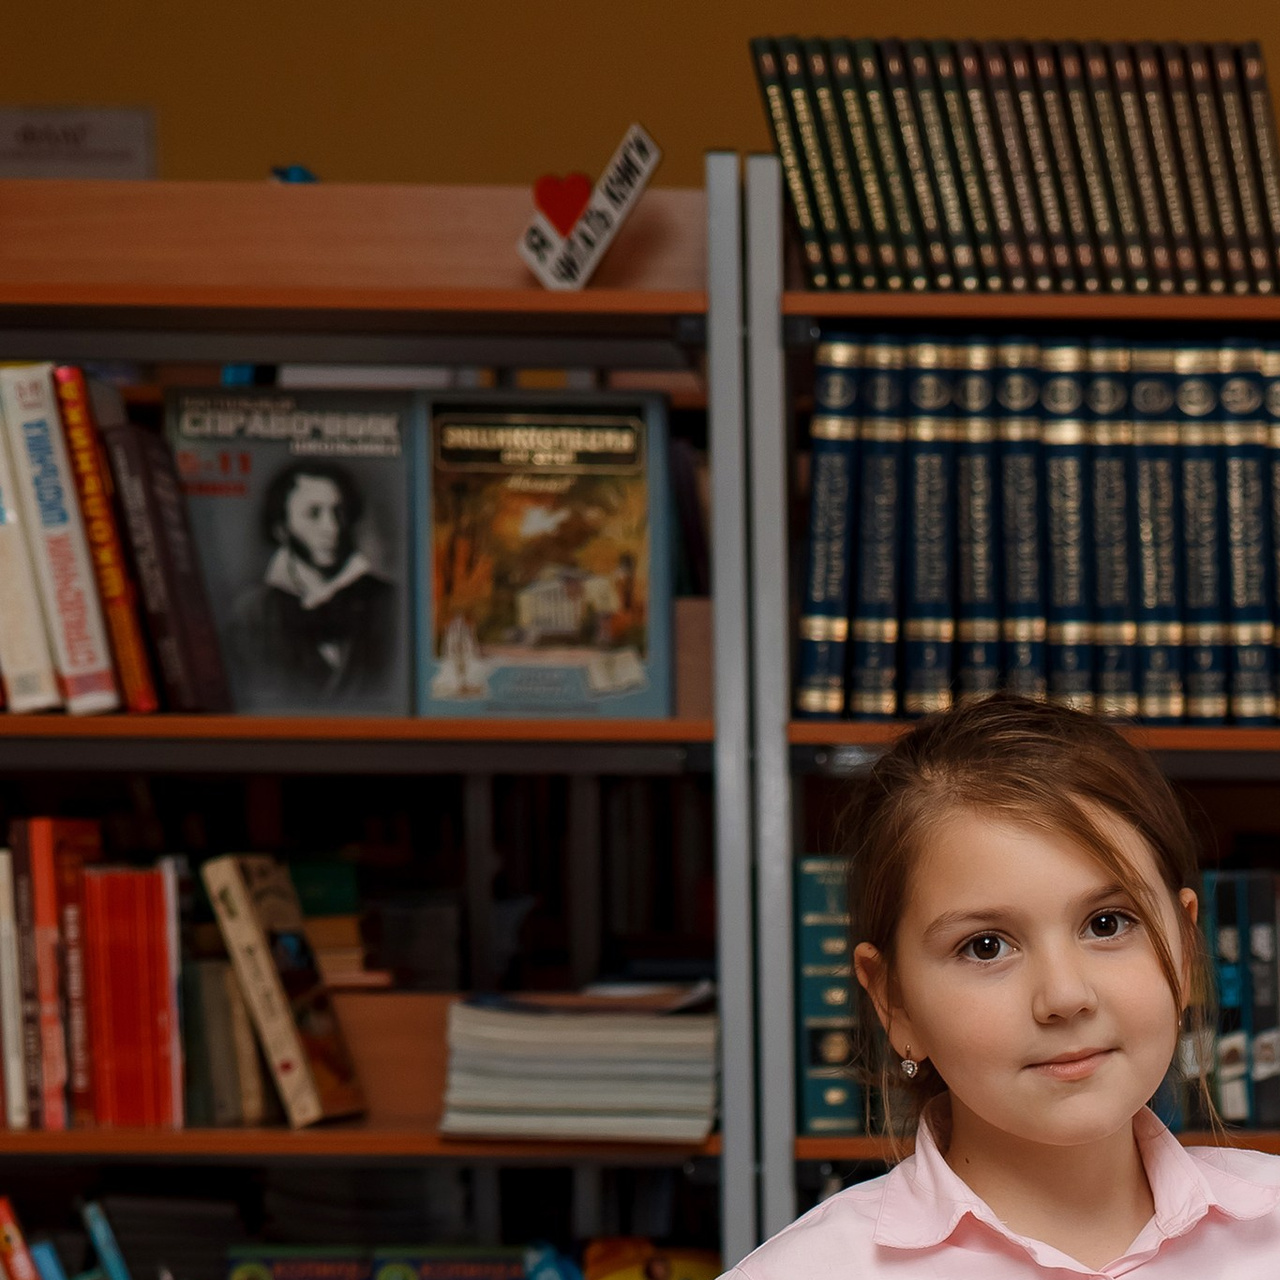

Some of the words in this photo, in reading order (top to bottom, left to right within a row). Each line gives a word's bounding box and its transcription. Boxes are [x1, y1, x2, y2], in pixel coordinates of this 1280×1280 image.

[526, 225, 552, 263] Я
[182, 411, 399, 439] СПРАВОЧНИК
[22, 418, 70, 528] ШКОЛЬНИКА
[57, 380, 127, 600] ШКОЛЬНИКА
